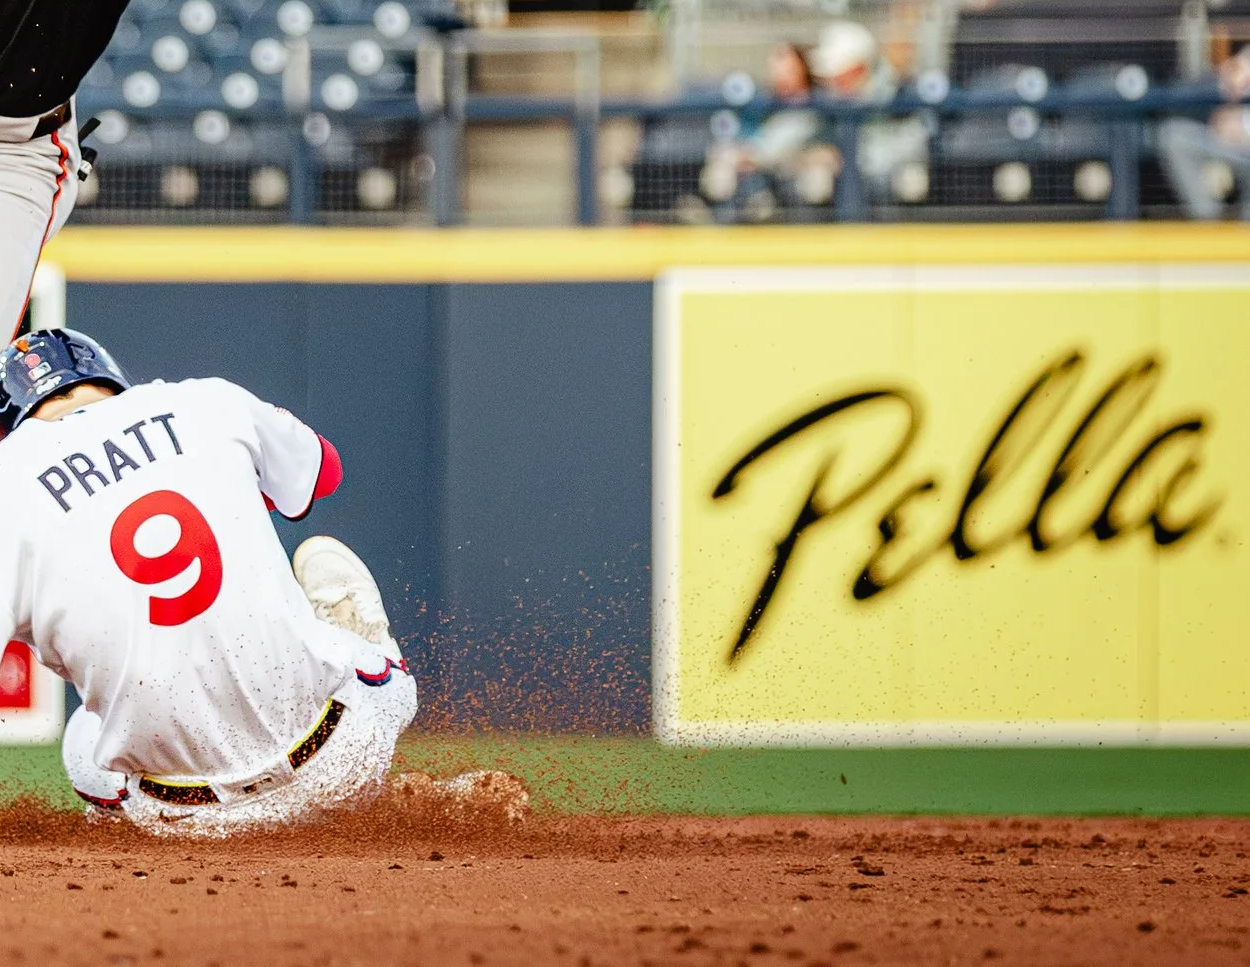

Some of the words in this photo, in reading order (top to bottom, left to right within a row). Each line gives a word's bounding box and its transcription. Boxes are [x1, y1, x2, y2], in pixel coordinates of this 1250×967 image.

[36, 412, 184, 514] PRATT
[712, 346, 1224, 668] Pella
[109, 489, 223, 627] 9
